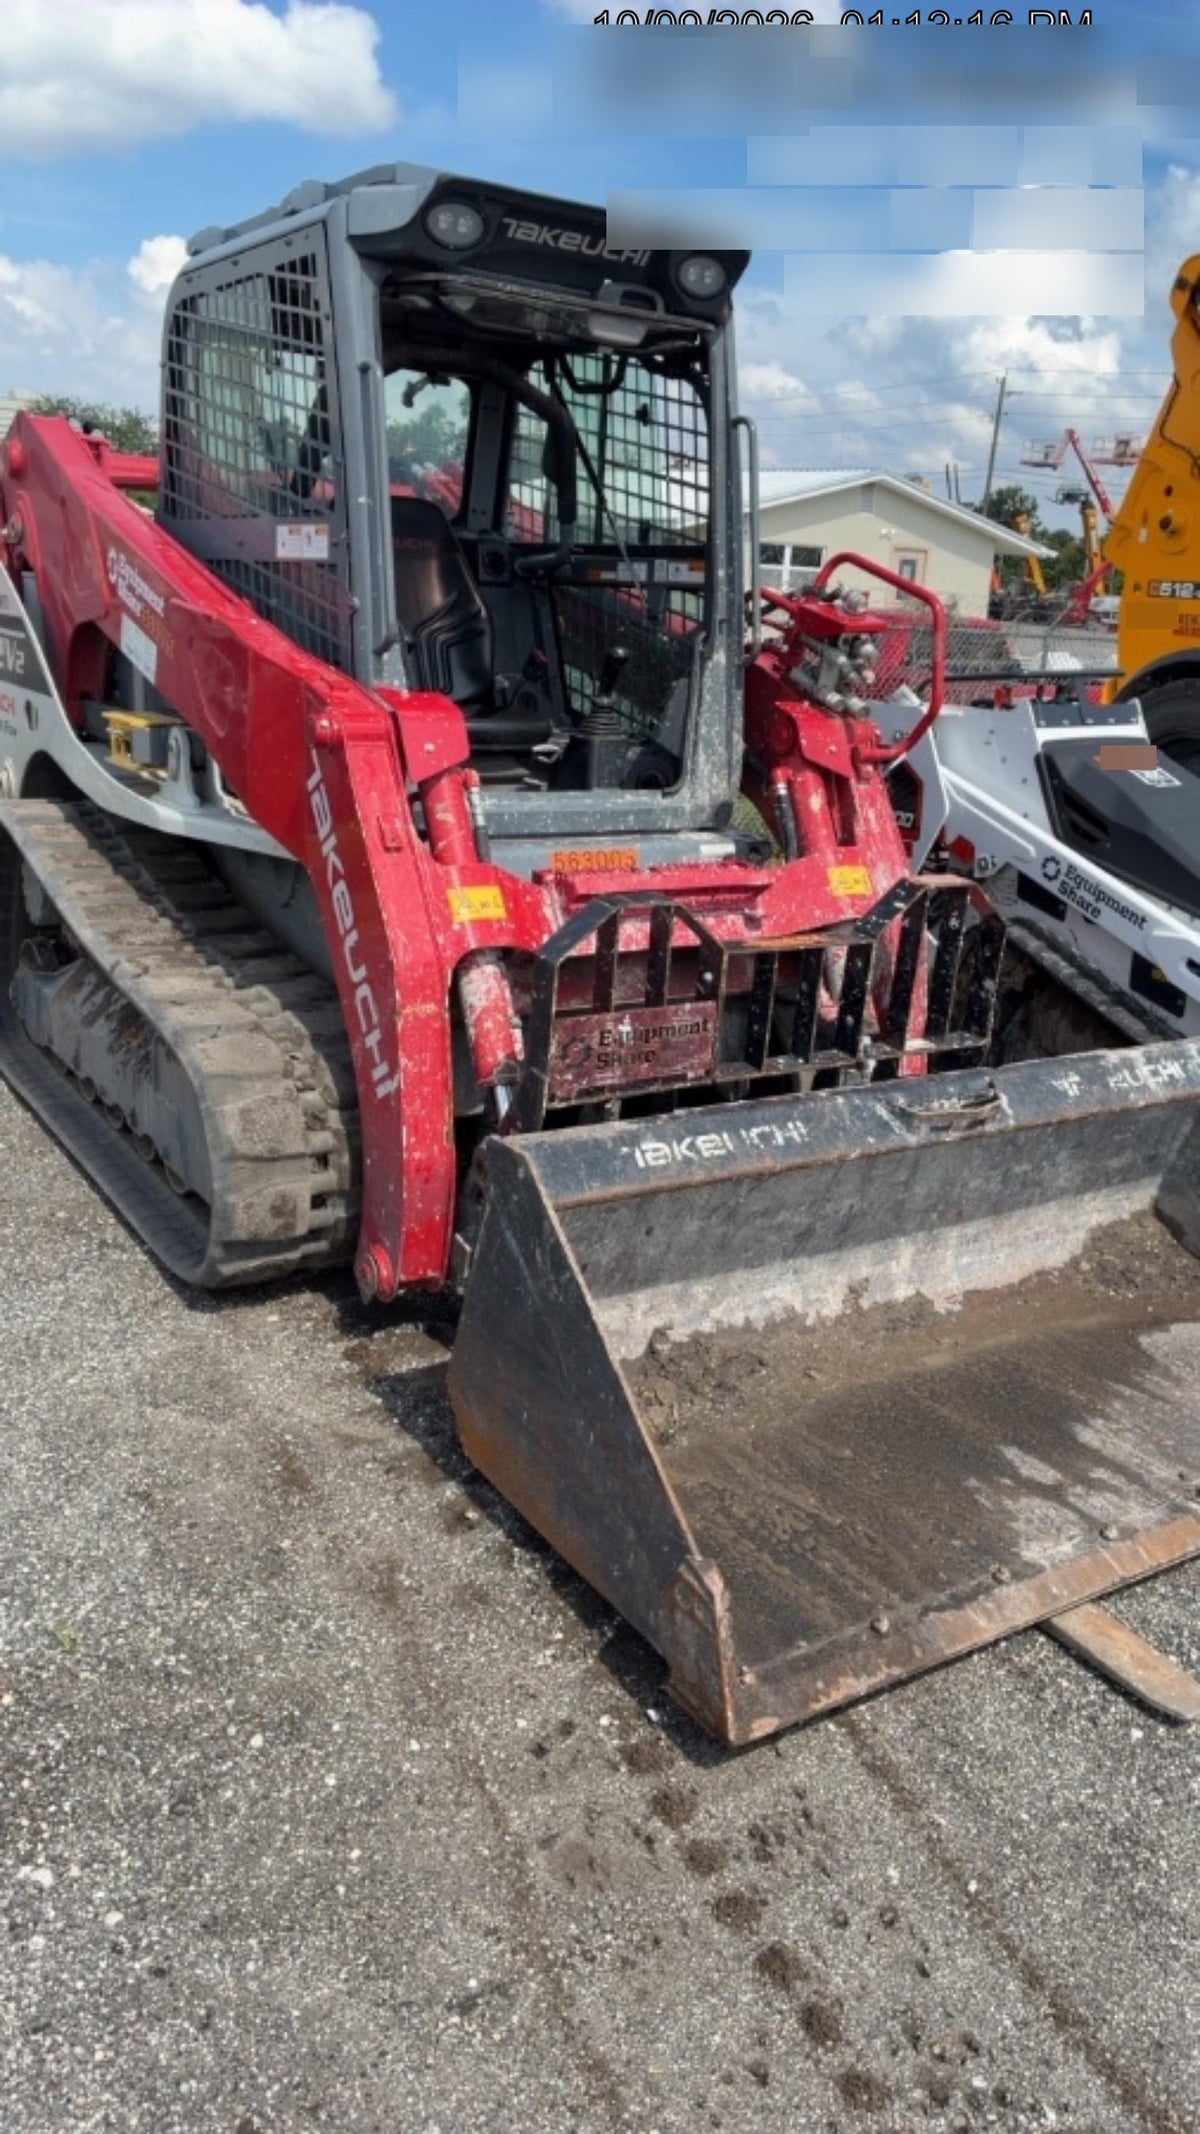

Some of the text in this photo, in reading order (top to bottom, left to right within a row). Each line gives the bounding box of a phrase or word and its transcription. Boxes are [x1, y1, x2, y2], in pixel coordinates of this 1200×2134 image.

[306, 744, 401, 1099] TAKEUCHI
[1058, 880, 1101, 919] Share
[1065, 864, 1147, 930] Equipment
